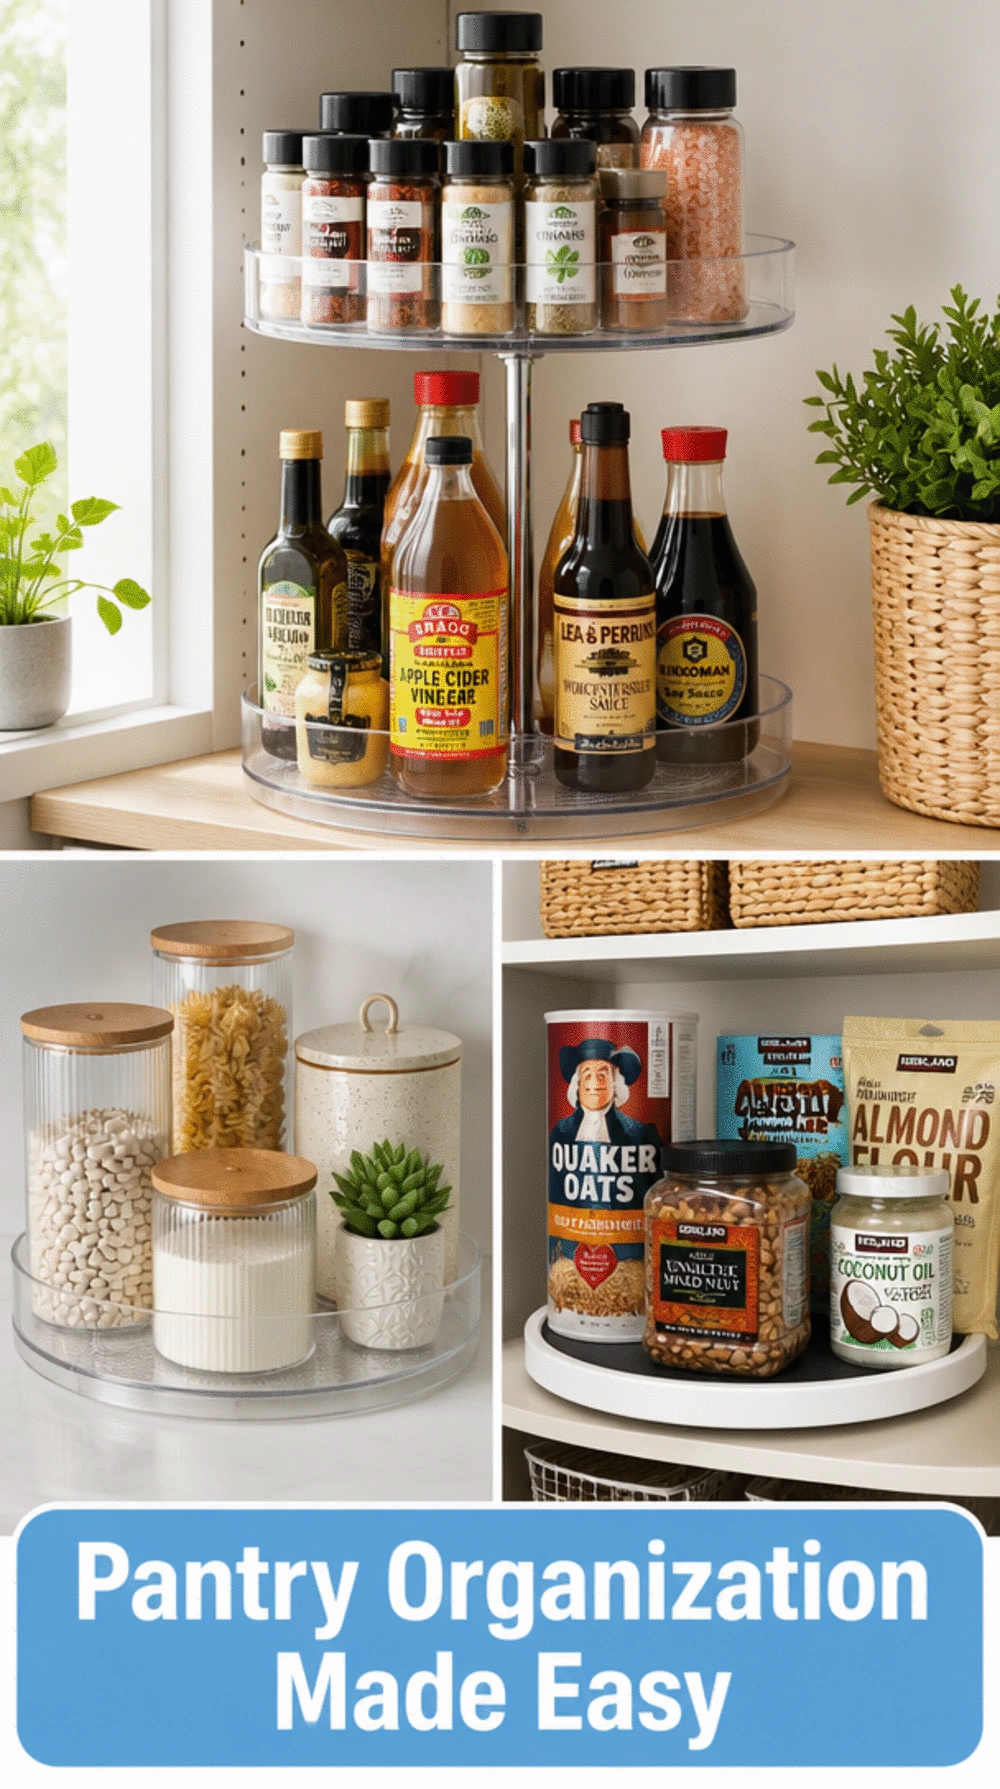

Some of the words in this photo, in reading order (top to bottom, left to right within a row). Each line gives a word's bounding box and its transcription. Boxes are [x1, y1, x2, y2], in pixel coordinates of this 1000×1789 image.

[561, 622, 584, 643] LEA
[400, 667, 440, 686] APPLE
[445, 669, 489, 687] CIDER
[853, 1103, 990, 1151] ALMOND
[552, 1142, 656, 1173] QUAKER
[563, 1174, 634, 1203] OATS
[838, 1258, 910, 1282] COCONUT
[912, 1262, 935, 1281] OIL
